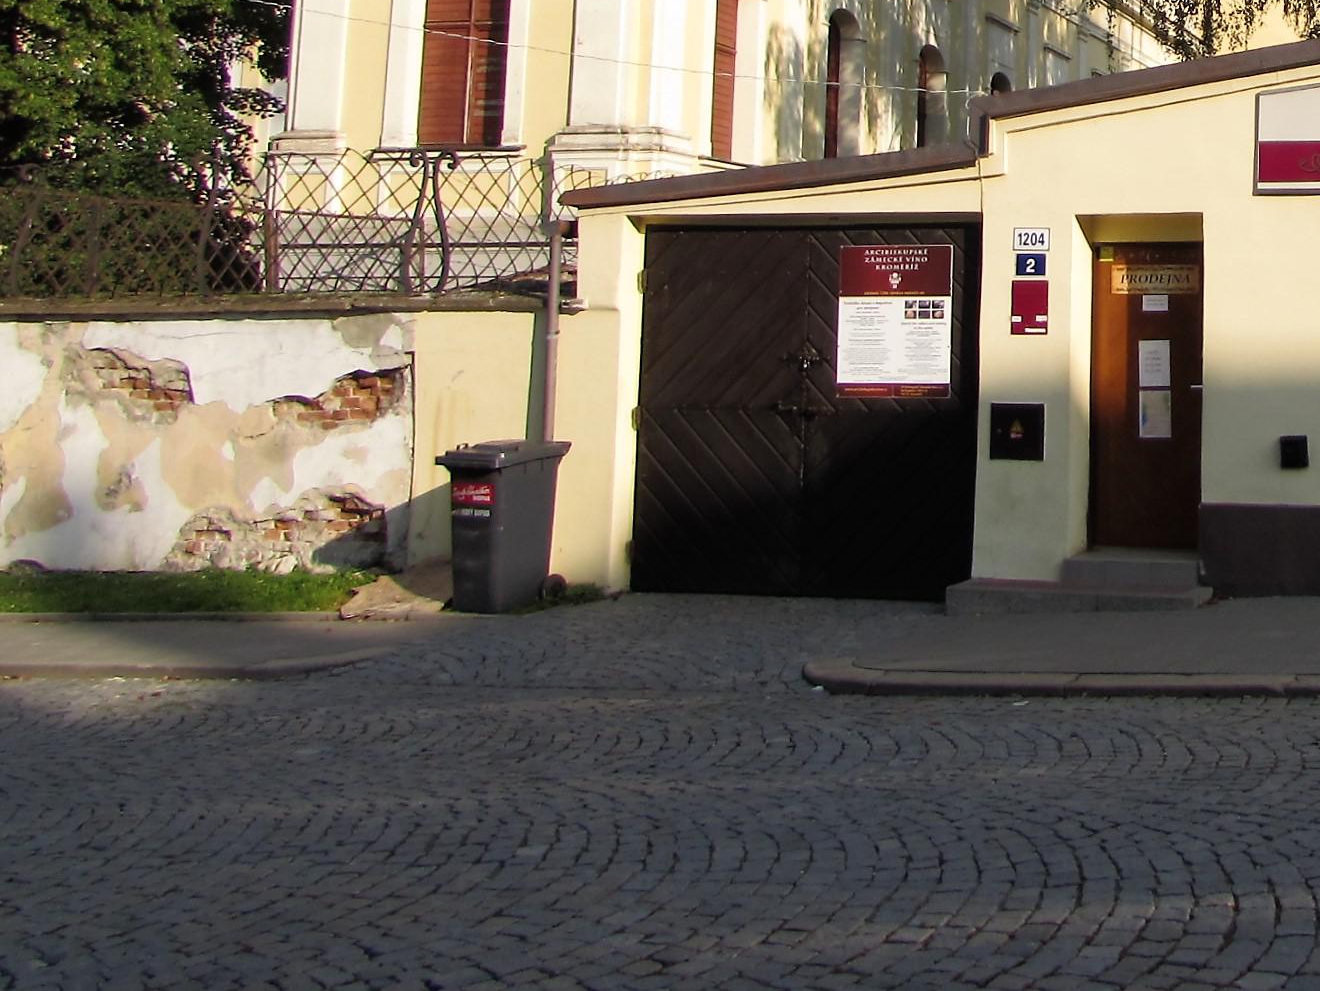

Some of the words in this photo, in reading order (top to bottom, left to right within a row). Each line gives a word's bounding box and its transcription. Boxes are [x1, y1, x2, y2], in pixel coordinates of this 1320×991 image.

[1017, 232, 1045, 246] 1204
[905, 255, 929, 263] VÍNO
[1025, 258, 1036, 273] 2
[1120, 273, 1191, 285] PRODEJNA
